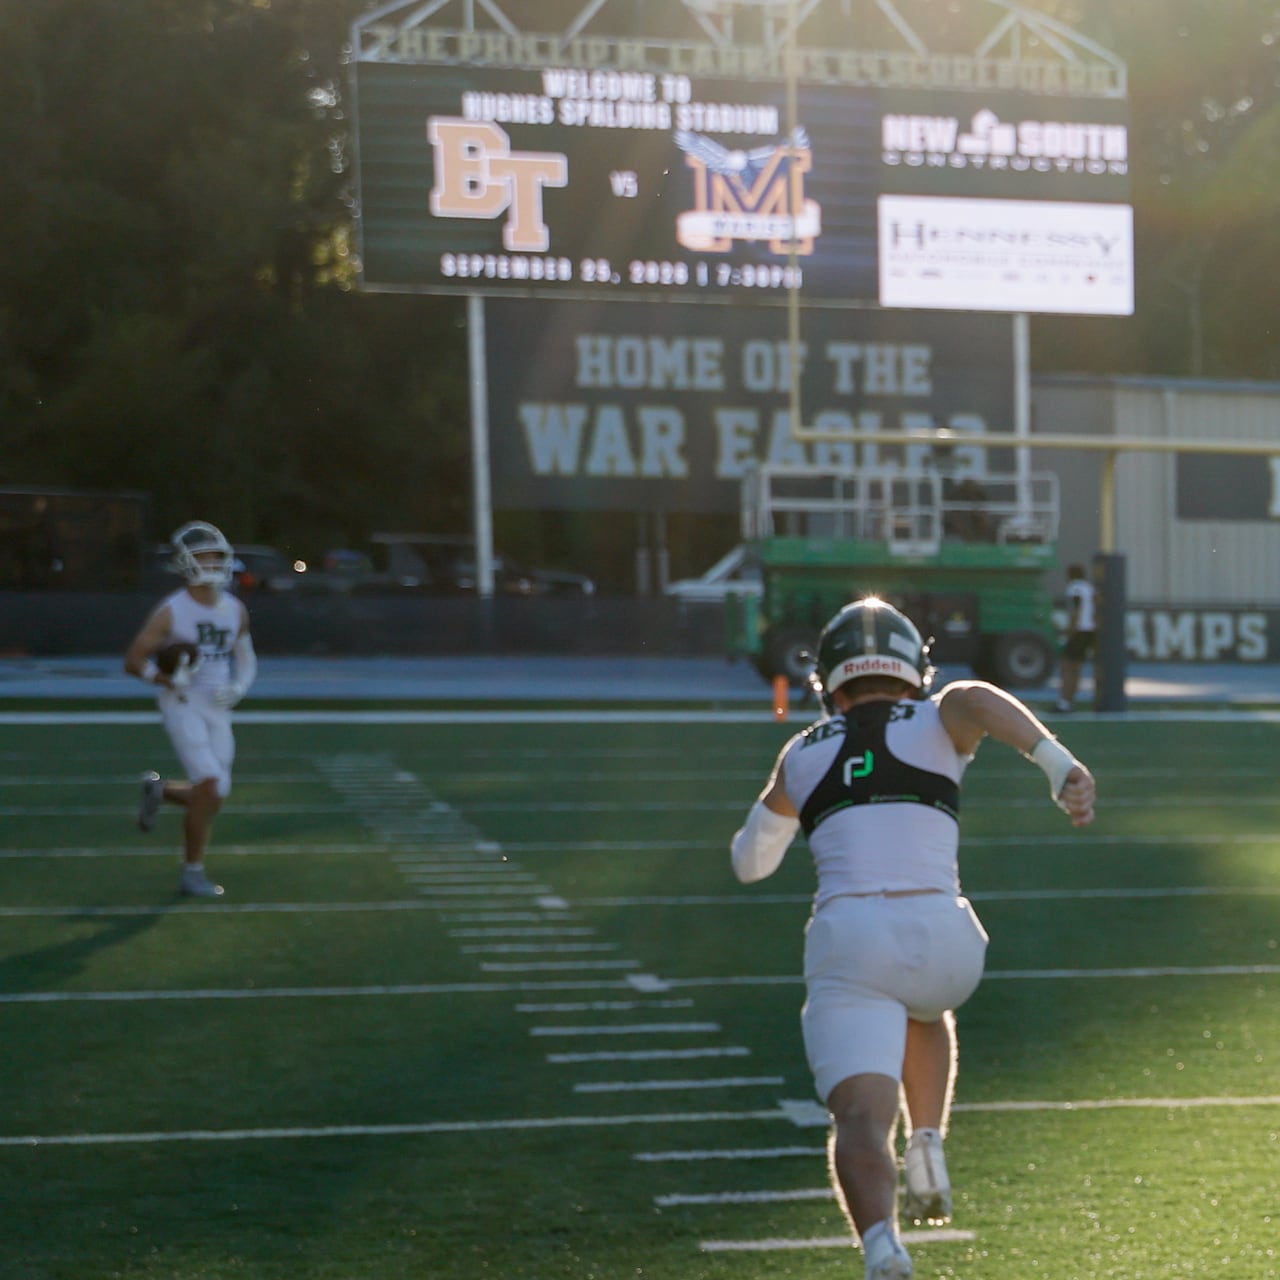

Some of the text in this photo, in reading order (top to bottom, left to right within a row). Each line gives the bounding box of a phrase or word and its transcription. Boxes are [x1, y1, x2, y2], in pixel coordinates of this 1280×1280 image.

[542, 67, 692, 104] WELCOME TO
[461, 90, 779, 136] HUGHES SPALDING STADIUM
[881, 114, 1129, 160] NEW SOUTH
[880, 150, 1129, 176] CONSTRUCTION
[426, 115, 569, 253] BT
[889, 220, 1122, 257] HENNESSY
[440, 252, 573, 282] SEPTEMBER
[575, 335, 932, 397] HOME OF THE
[519, 402, 689, 478] WAR
[843, 658, 902, 675] Riddell
